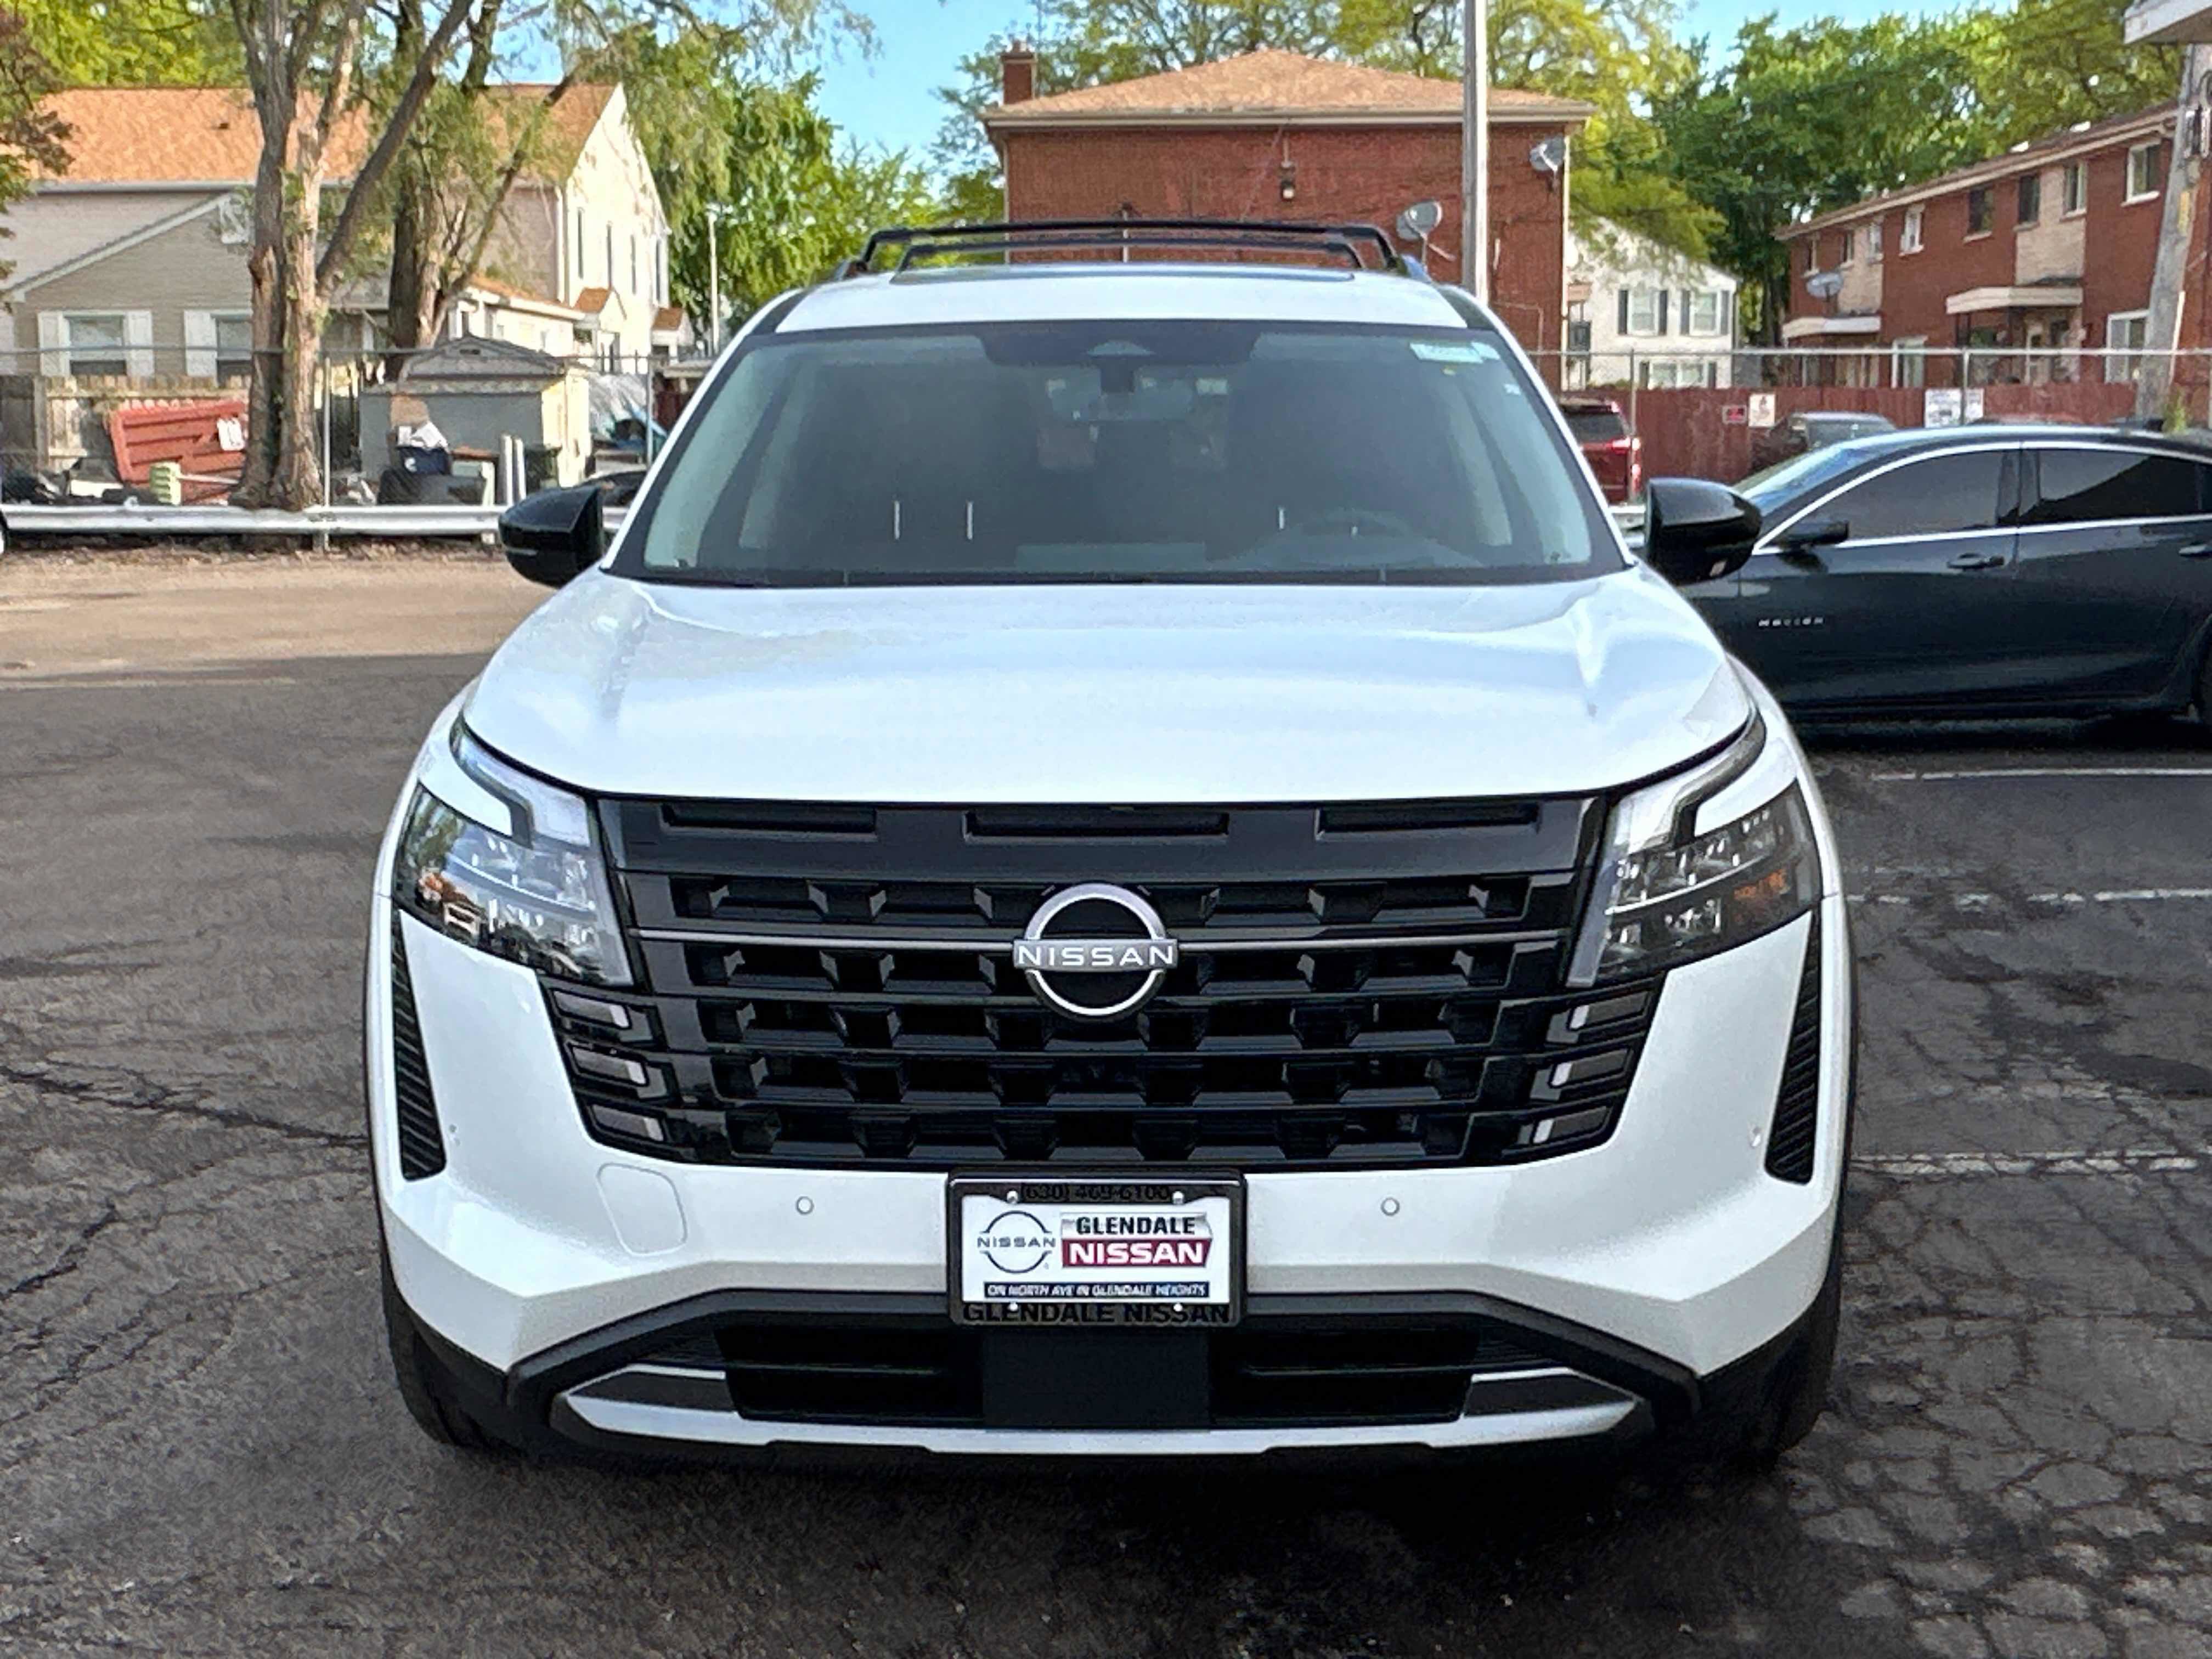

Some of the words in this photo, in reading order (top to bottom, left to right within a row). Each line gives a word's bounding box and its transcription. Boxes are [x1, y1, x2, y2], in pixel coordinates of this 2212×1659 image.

[1018, 945, 1173, 966] NISSAN
[1075, 1216, 1196, 1235] GLENDALE
[977, 1236, 1056, 1248] NISSAN
[1069, 1242, 1204, 1265] NISSAN
[988, 1284, 1006, 1296] ON
[1008, 1284, 1049, 1296] NORTH
[1092, 1284, 1152, 1296] GLENDALE
[963, 1302, 1115, 1322] GLENDALE
[1124, 1302, 1230, 1322] NISSAN
